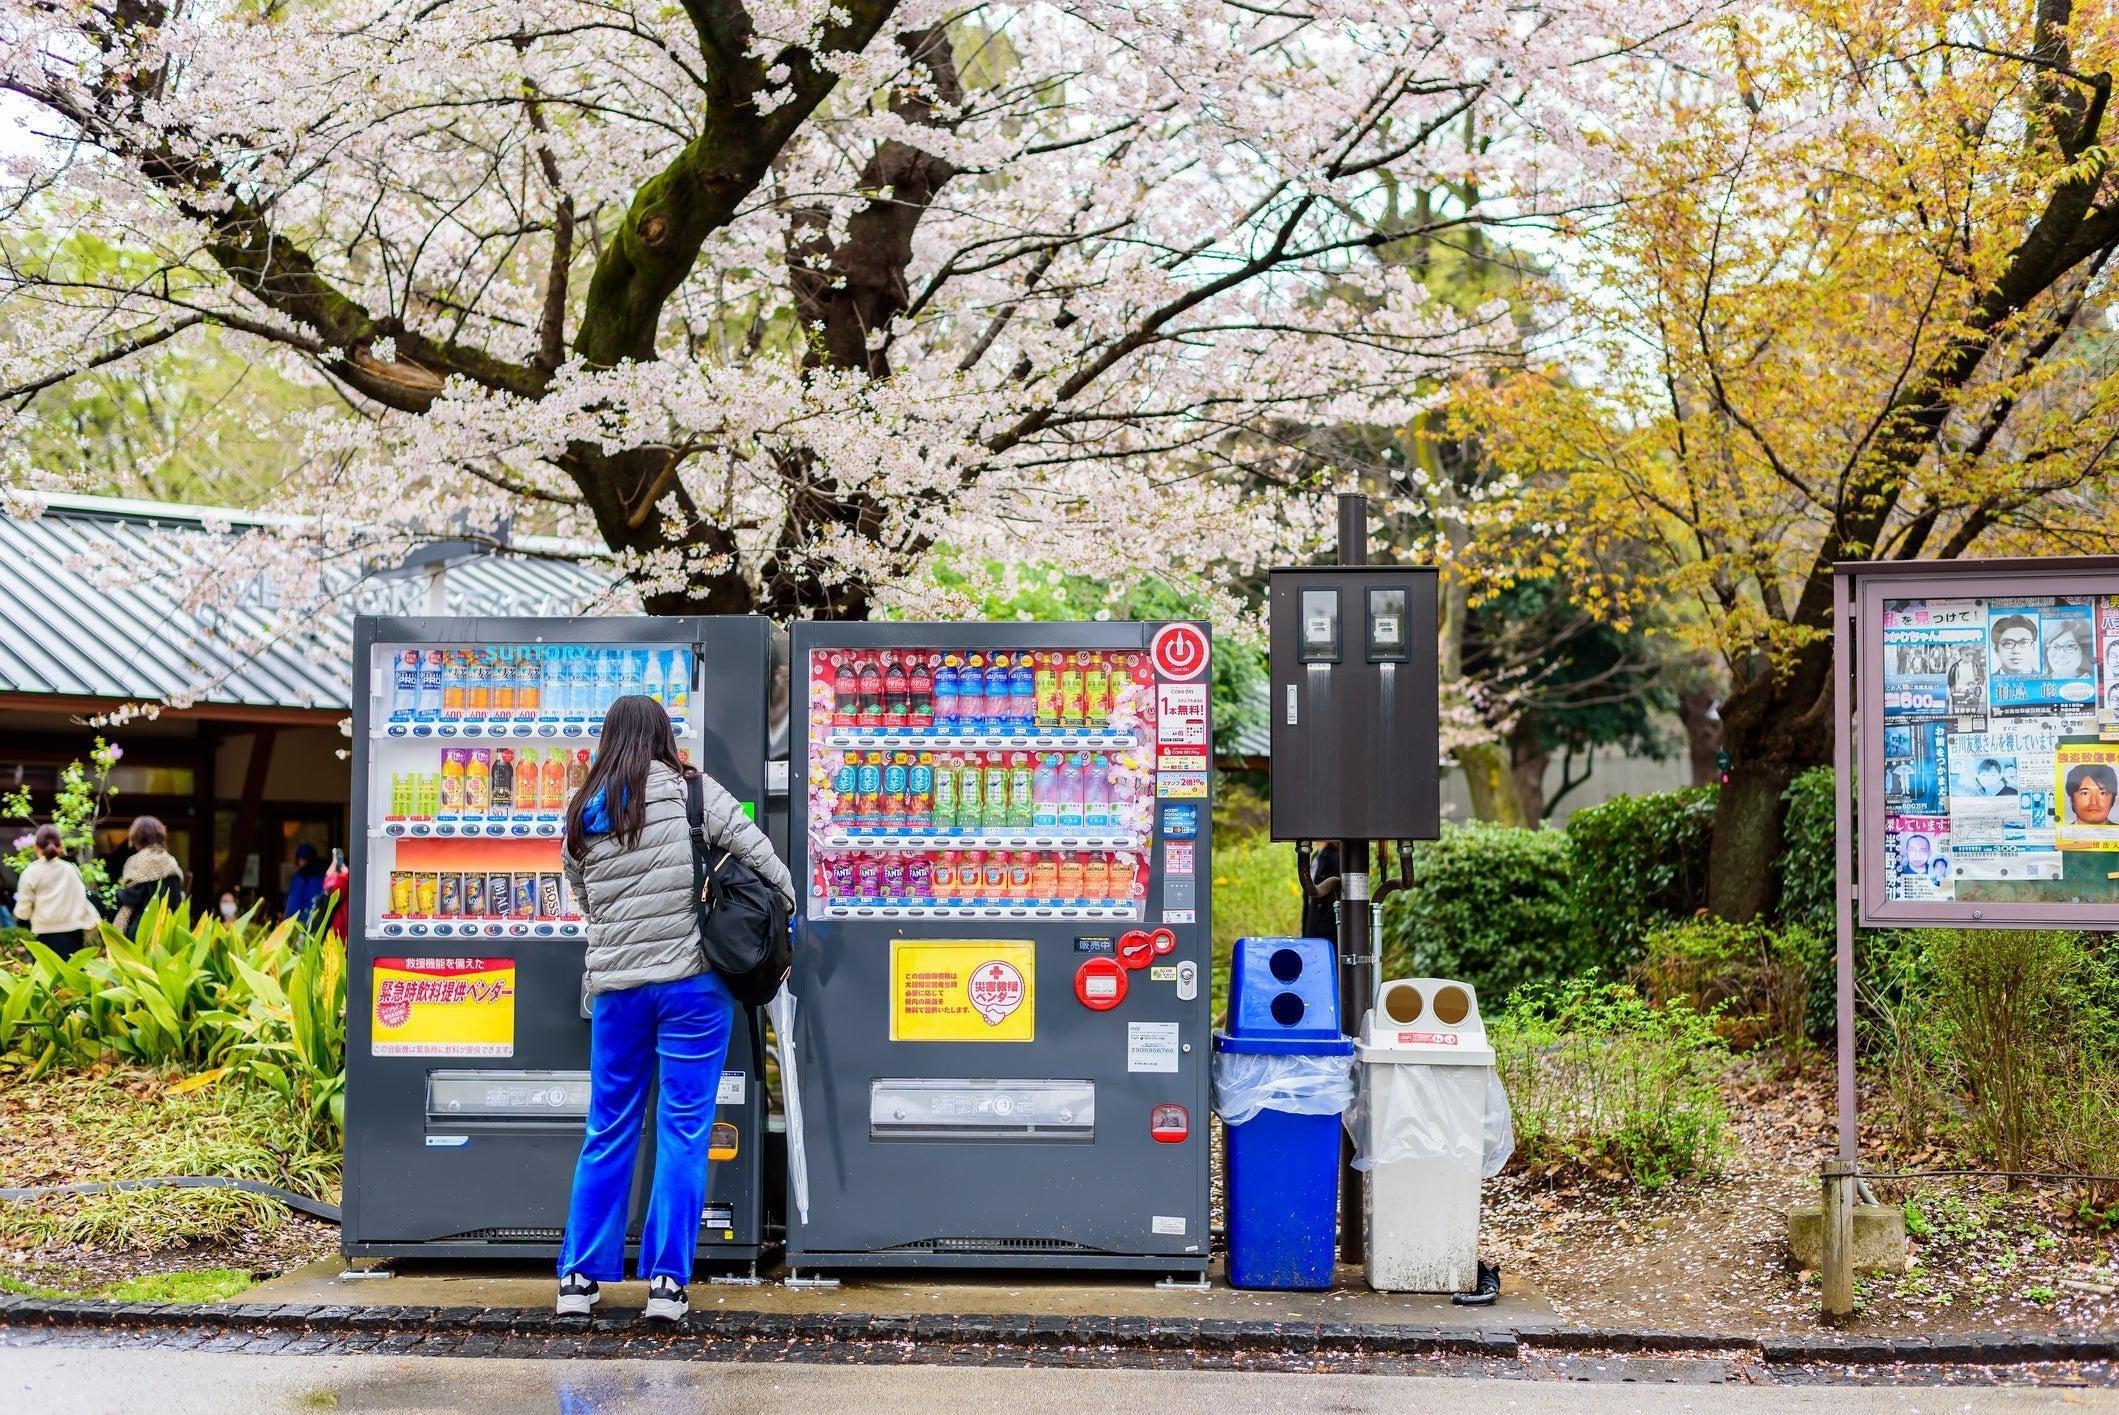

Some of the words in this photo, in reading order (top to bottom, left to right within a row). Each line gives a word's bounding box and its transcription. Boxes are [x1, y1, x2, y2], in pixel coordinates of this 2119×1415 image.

[486, 645, 591, 660] SUNTORY
[2057, 752, 2119, 763] 強盗致傷事
[545, 885, 560, 917] BOSS
[405, 958, 485, 970] 救援機能を備えた
[378, 979, 514, 1004] 緊急時飲料提供ベンダー
[975, 981, 1018, 993] 災害救援
[976, 992, 1017, 1003] ベンダー
